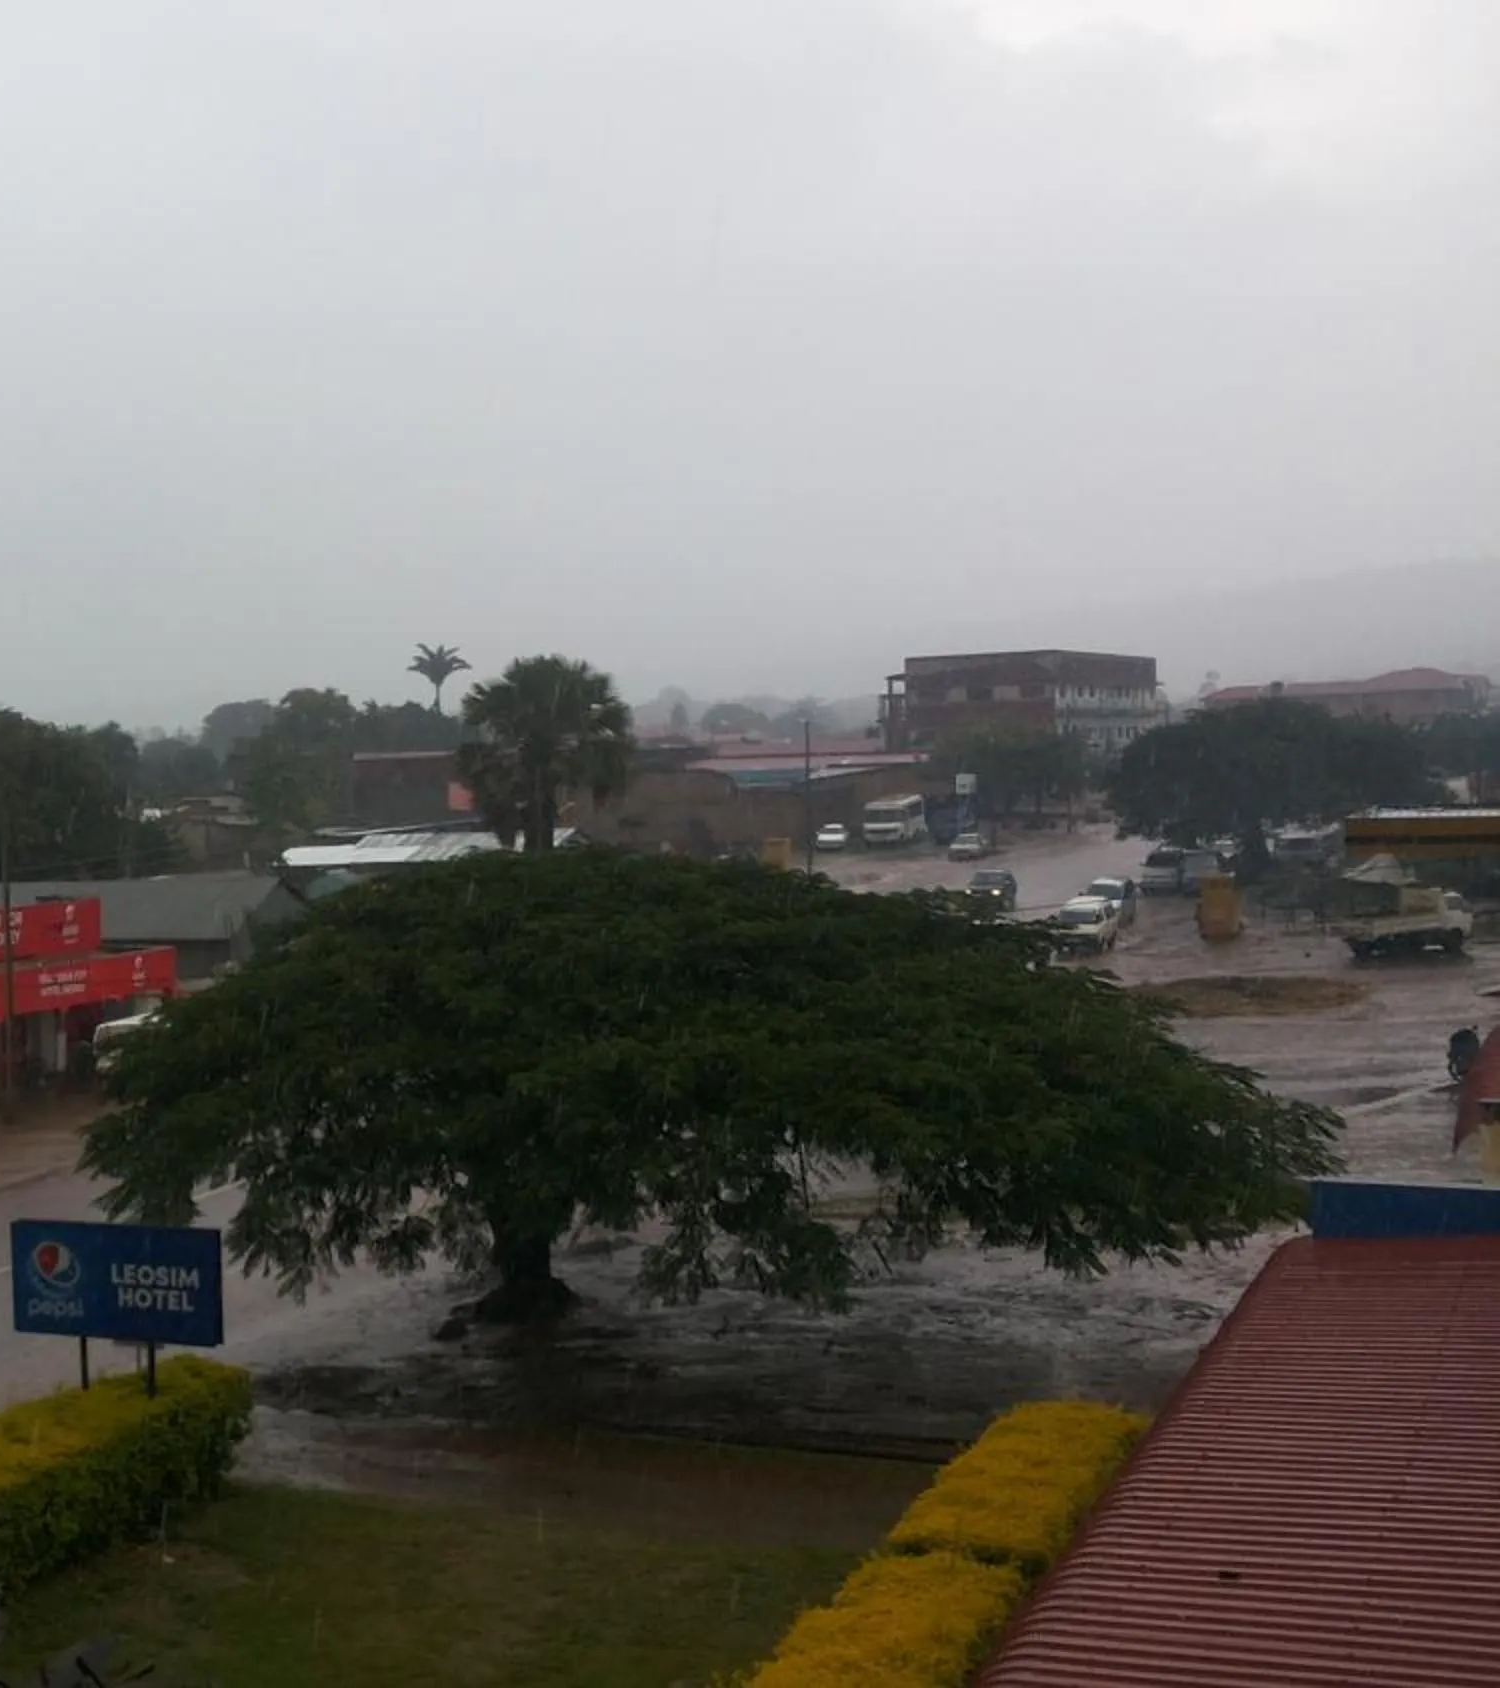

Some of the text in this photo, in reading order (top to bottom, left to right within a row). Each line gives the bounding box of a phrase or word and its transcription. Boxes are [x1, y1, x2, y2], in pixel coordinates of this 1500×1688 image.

[110, 1263, 200, 1290] LEOSIM
[27, 1298, 84, 1318] pepsi
[117, 1286, 196, 1312] HOTEL
